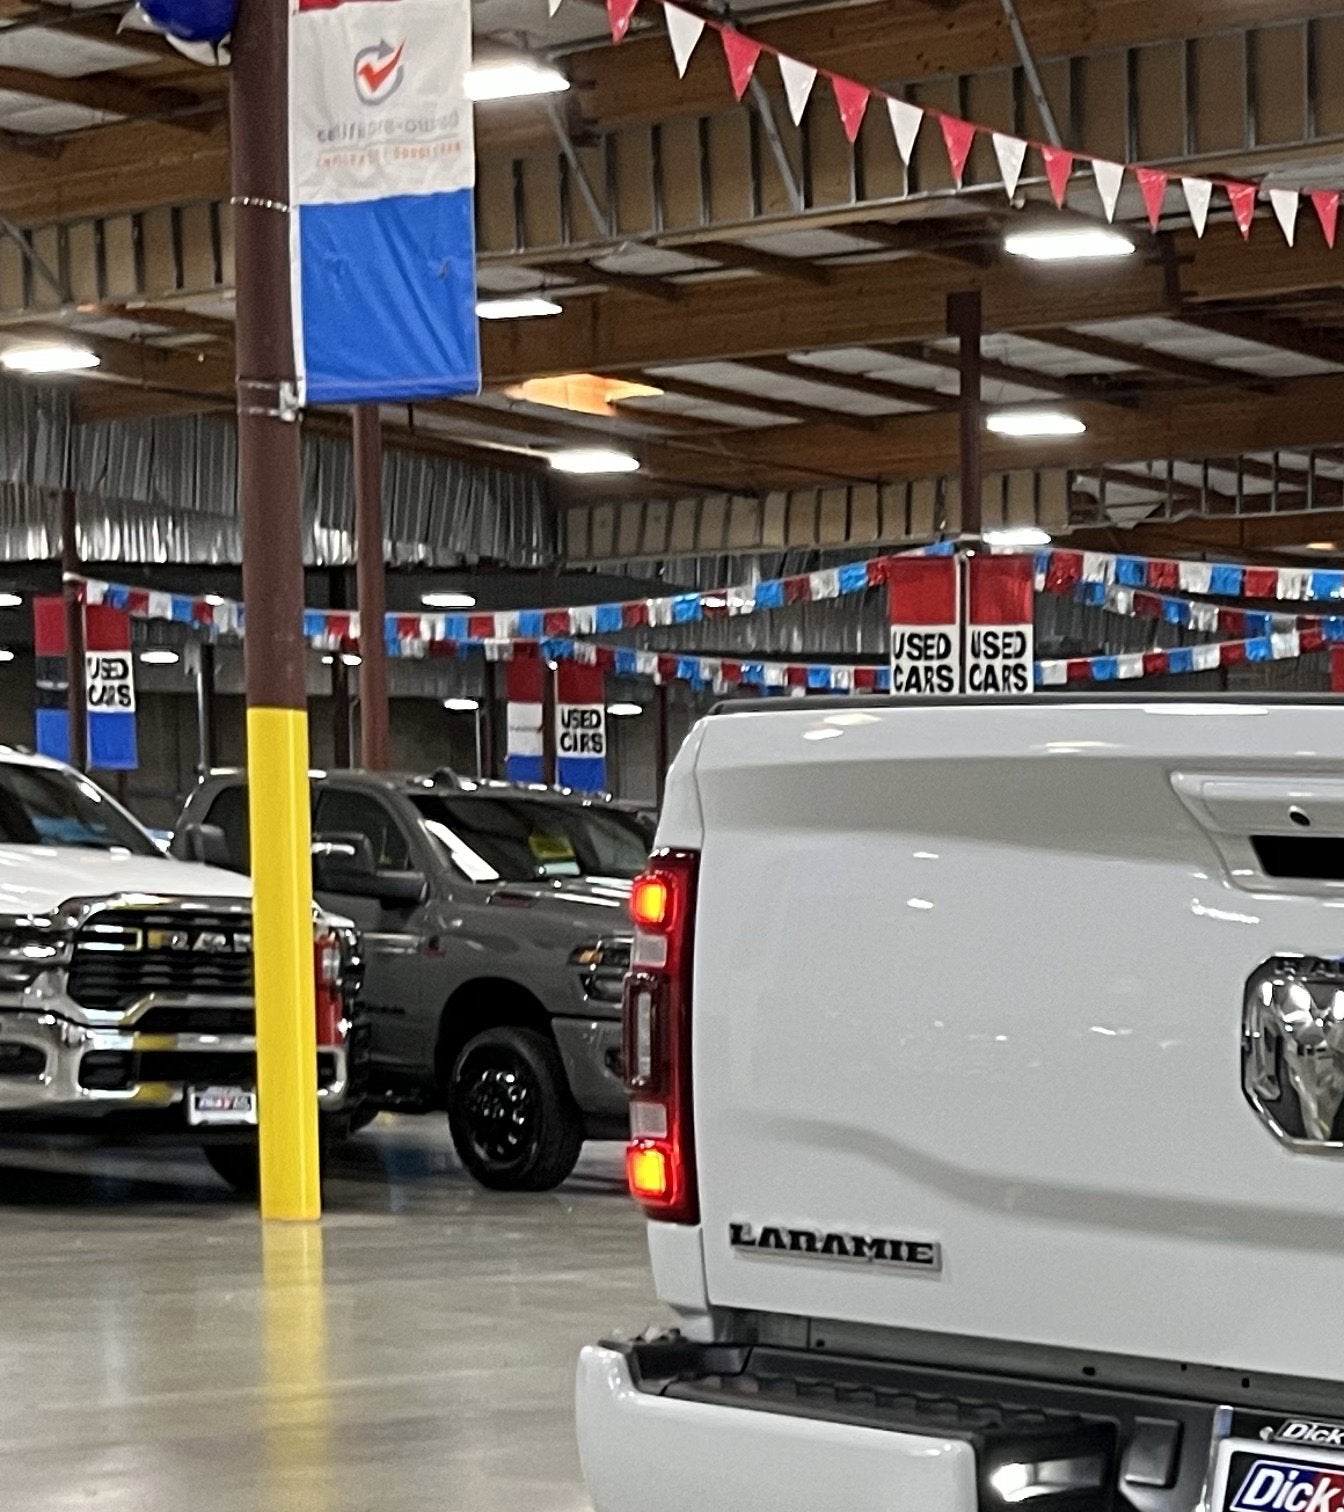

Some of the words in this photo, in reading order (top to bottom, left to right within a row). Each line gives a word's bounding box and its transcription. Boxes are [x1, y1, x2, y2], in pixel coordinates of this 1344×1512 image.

[893, 631, 951, 661] USED
[971, 630, 1027, 660] USED
[893, 664, 954, 693] CARS
[969, 663, 1028, 692] CARS
[561, 708, 602, 730] USED
[729, 1221, 942, 1272] LARAMIE
